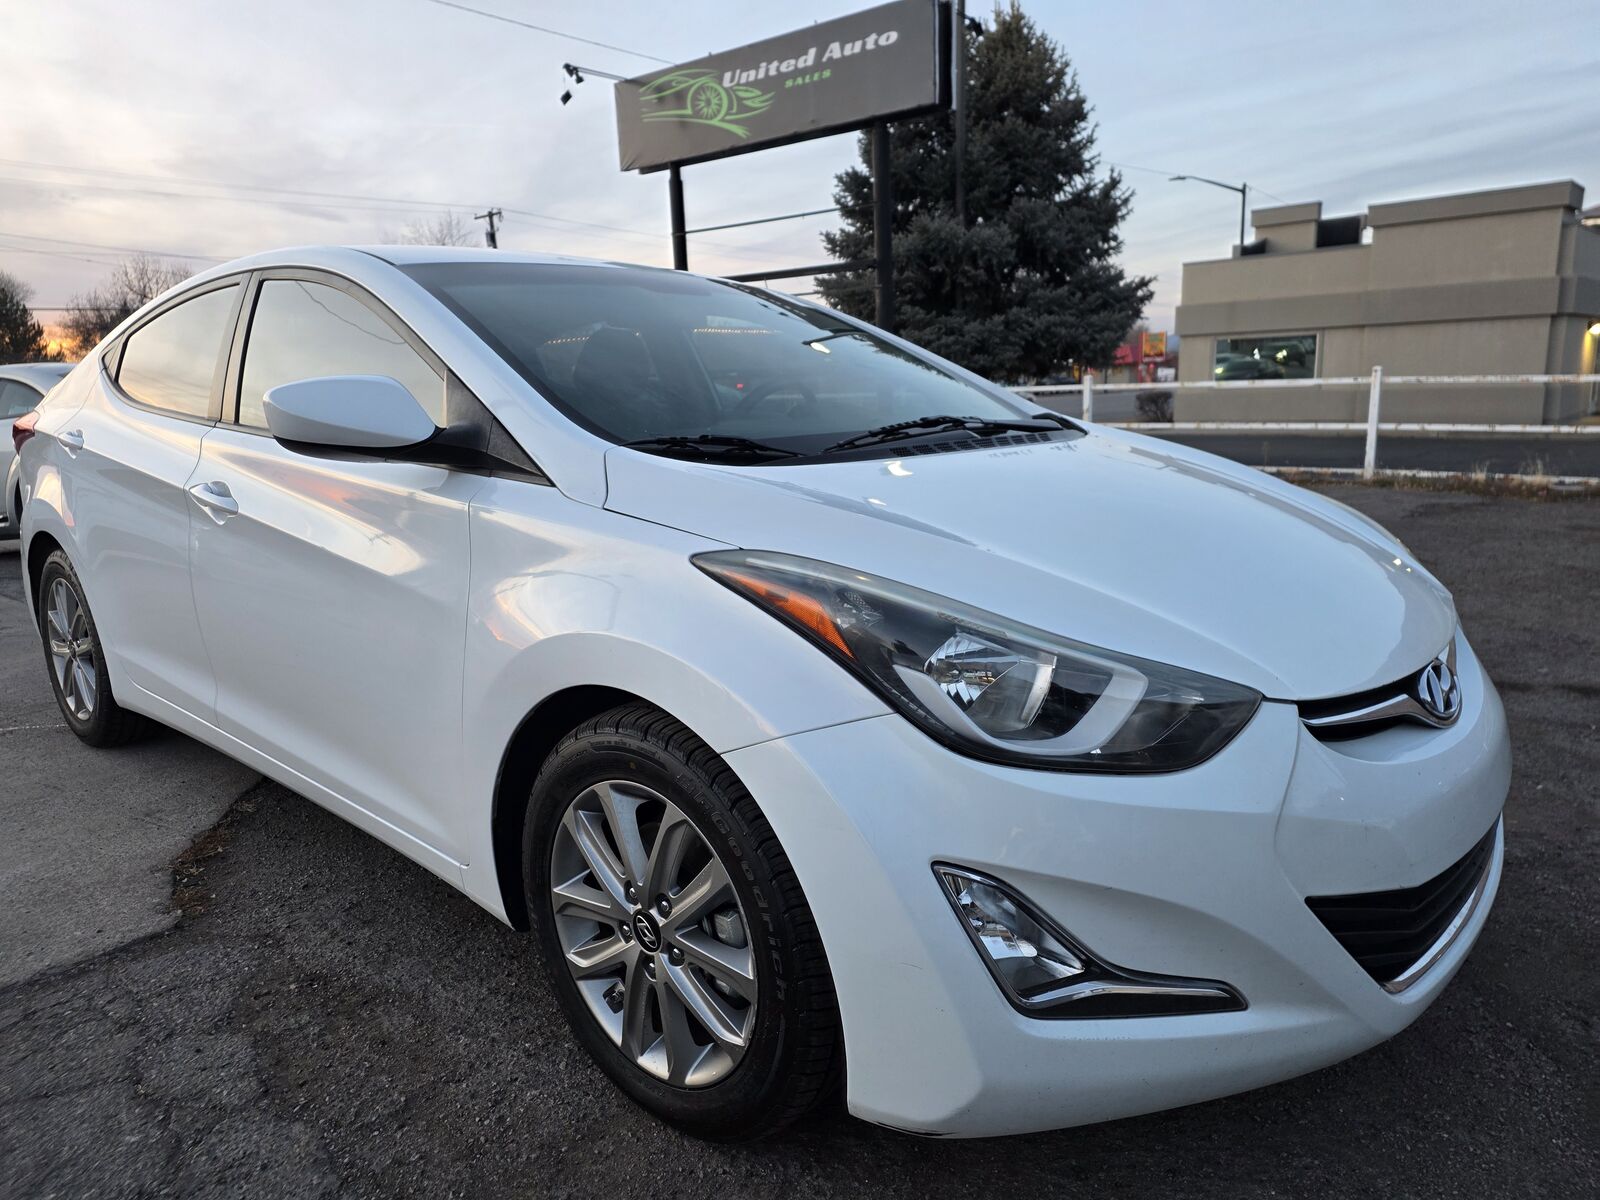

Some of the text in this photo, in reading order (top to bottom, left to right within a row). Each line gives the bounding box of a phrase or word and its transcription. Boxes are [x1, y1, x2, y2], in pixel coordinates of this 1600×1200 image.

[722, 30, 899, 88] United Auto
[784, 69, 832, 89] SALES
